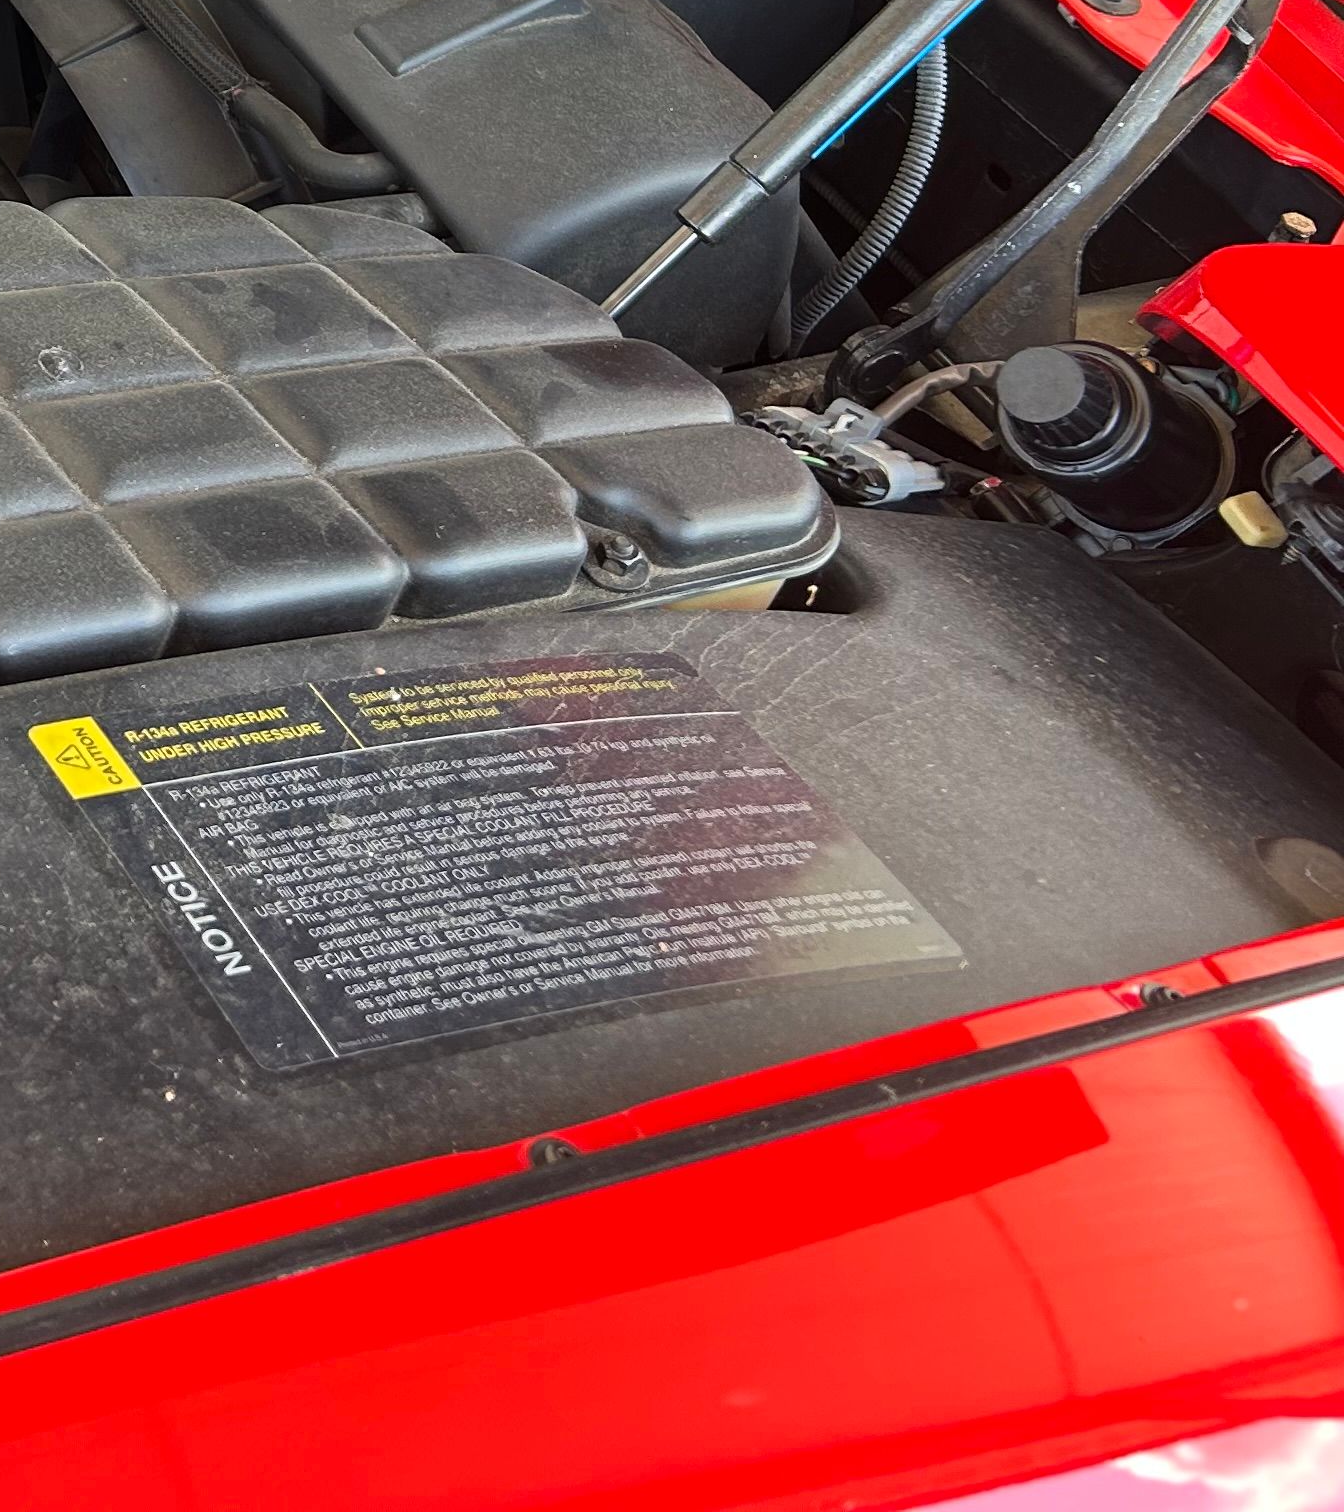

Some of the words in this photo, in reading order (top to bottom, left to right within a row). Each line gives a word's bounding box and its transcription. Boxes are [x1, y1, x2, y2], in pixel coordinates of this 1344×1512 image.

[414, 685, 434, 693] be
[124, 725, 180, 744] R-134a
[180, 708, 290, 732] REFRIGERANT
[139, 742, 199, 763] UNDER
[198, 737, 239, 750] HIGH
[240, 723, 325, 743] PRESSURE
[371, 720, 399, 728] See
[400, 713, 450, 724] Service
[72, 727, 124, 786] CAUTION
[170, 786, 218, 799] R-134a
[220, 768, 322, 791] REFRIGERANT
[306, 787, 372, 805] equivalent
[373, 785, 387, 793] or
[387, 779, 412, 790] A/C
[415, 775, 459, 787] system
[481, 768, 497, 777] be
[197, 826, 223, 838] AIR
[226, 820, 258, 832] BAG
[225, 862, 260, 875] THIS
[262, 851, 327, 869] VEHICLE
[327, 838, 403, 857] REQUIRES
[402, 835, 415, 844] A
[414, 825, 473, 841] SPECIAL
[474, 815, 542, 831] COOLANT
[542, 811, 571, 821] FILL
[570, 800, 655, 818] PROCEDURE
[244, 842, 294, 857] Manual
[295, 838, 314, 848] for
[314, 827, 381, 847] diagnostic
[381, 822, 407, 833] and
[455, 805, 524, 823] procedures
[524, 800, 564, 810] before
[253, 902, 287, 915] USE
[380, 872, 452, 891] COOLANT
[451, 866, 491, 878] ONLY
[277, 885, 294, 896] fill
[294, 874, 361, 895] procedure
[361, 867, 398, 880] could
[399, 860, 437, 872] result
[437, 857, 450, 866] in
[499, 844, 552, 856] damage
[550, 840, 566, 849] to
[565, 837, 585, 847] the
[151, 861, 252, 977] NOTICE
[317, 931, 381, 950] extended
[381, 926, 403, 938] life
[404, 920, 450, 935] engine
[502, 905, 528, 915] See
[533, 901, 560, 911] your
[560, 890, 613, 905] Owner's
[294, 950, 360, 971] SPECIAL
[360, 939, 419, 957] ENGINE
[418, 934, 444, 946] OIL
[445, 920, 522, 940] REQUIRED
[432, 996, 462, 1009] See
[461, 985, 518, 1003] Owner's
[518, 982, 534, 992] or
[535, 972, 585, 990] Service
[584, 964, 634, 980] Manual
[633, 959, 653, 970] for
[654, 956, 687, 967] more
